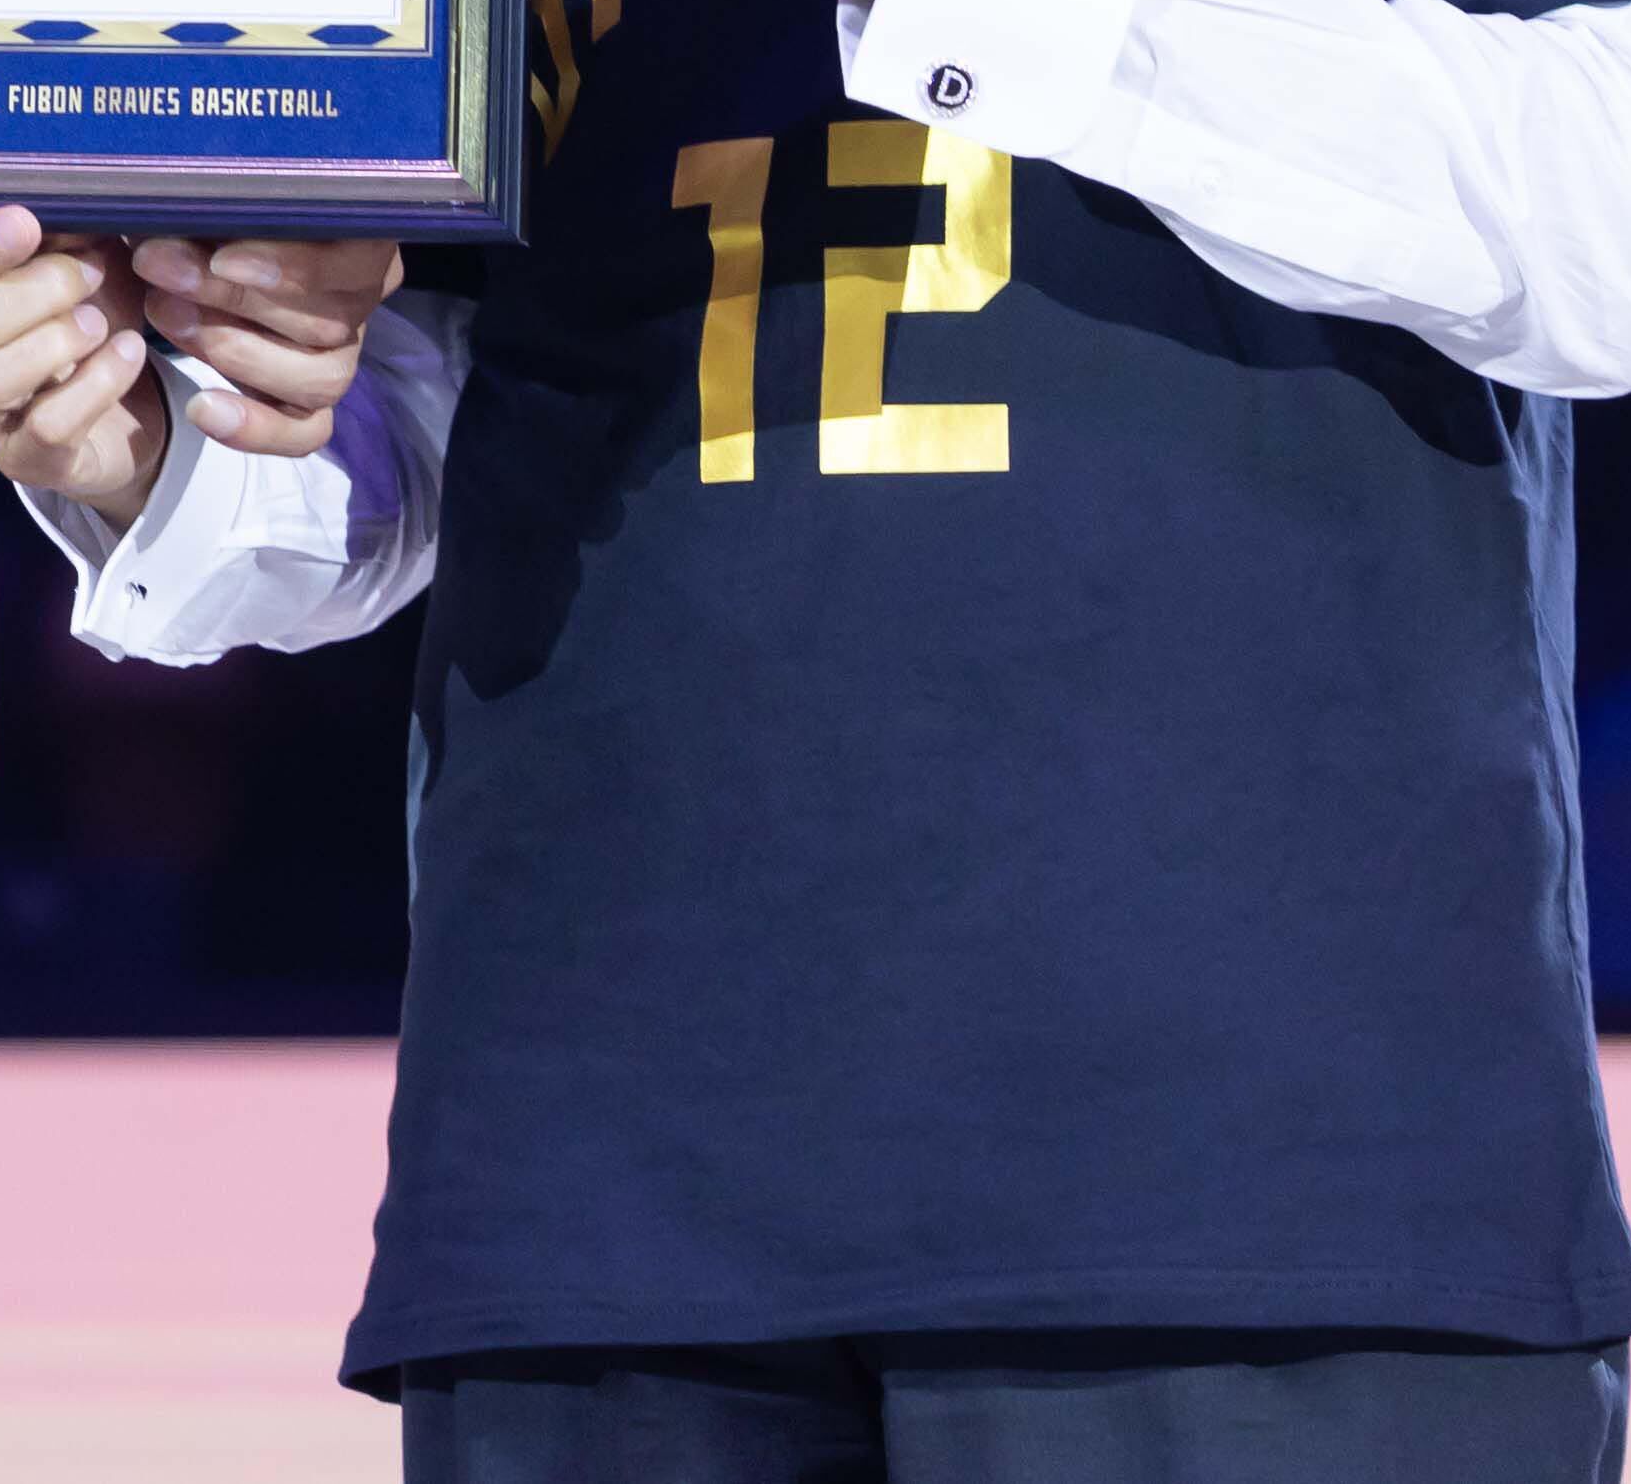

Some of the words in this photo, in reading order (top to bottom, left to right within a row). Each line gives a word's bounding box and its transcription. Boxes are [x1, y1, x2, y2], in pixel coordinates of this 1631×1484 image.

[8, 84, 83, 114] FUBON
[93, 85, 181, 115] BRAVES
[190, 86, 339, 118] BASKETBALL
[671, 119, 1012, 483] 12
